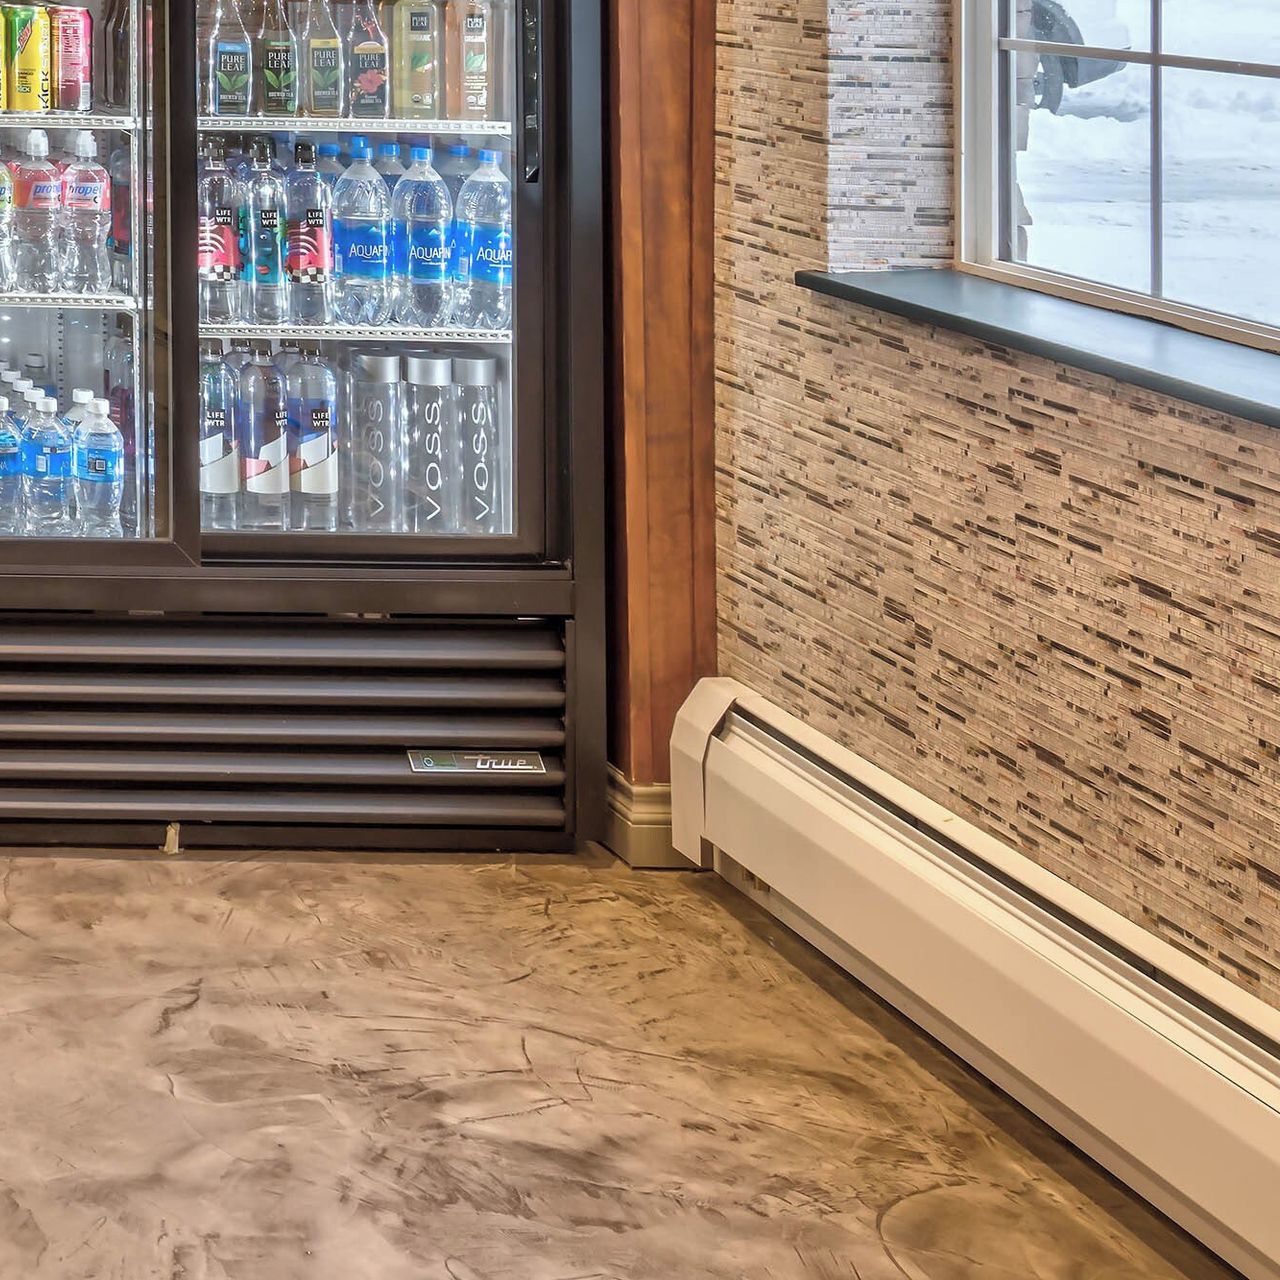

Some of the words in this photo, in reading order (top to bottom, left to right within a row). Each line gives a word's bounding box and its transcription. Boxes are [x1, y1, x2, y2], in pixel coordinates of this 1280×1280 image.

[221, 54, 245, 63] PURE
[268, 52, 292, 60] PURE
[314, 50, 336, 59] PURE
[221, 63, 245, 71] LEAF
[268, 60, 292, 68] LEAF
[314, 58, 336, 67] LEAF
[359, 60, 380, 68] LEAF
[207, 411, 225, 419] LIFE
[369, 399, 385, 518] VOSS
[425, 402, 441, 520] VOSS
[471, 401, 490, 520] VOSS
